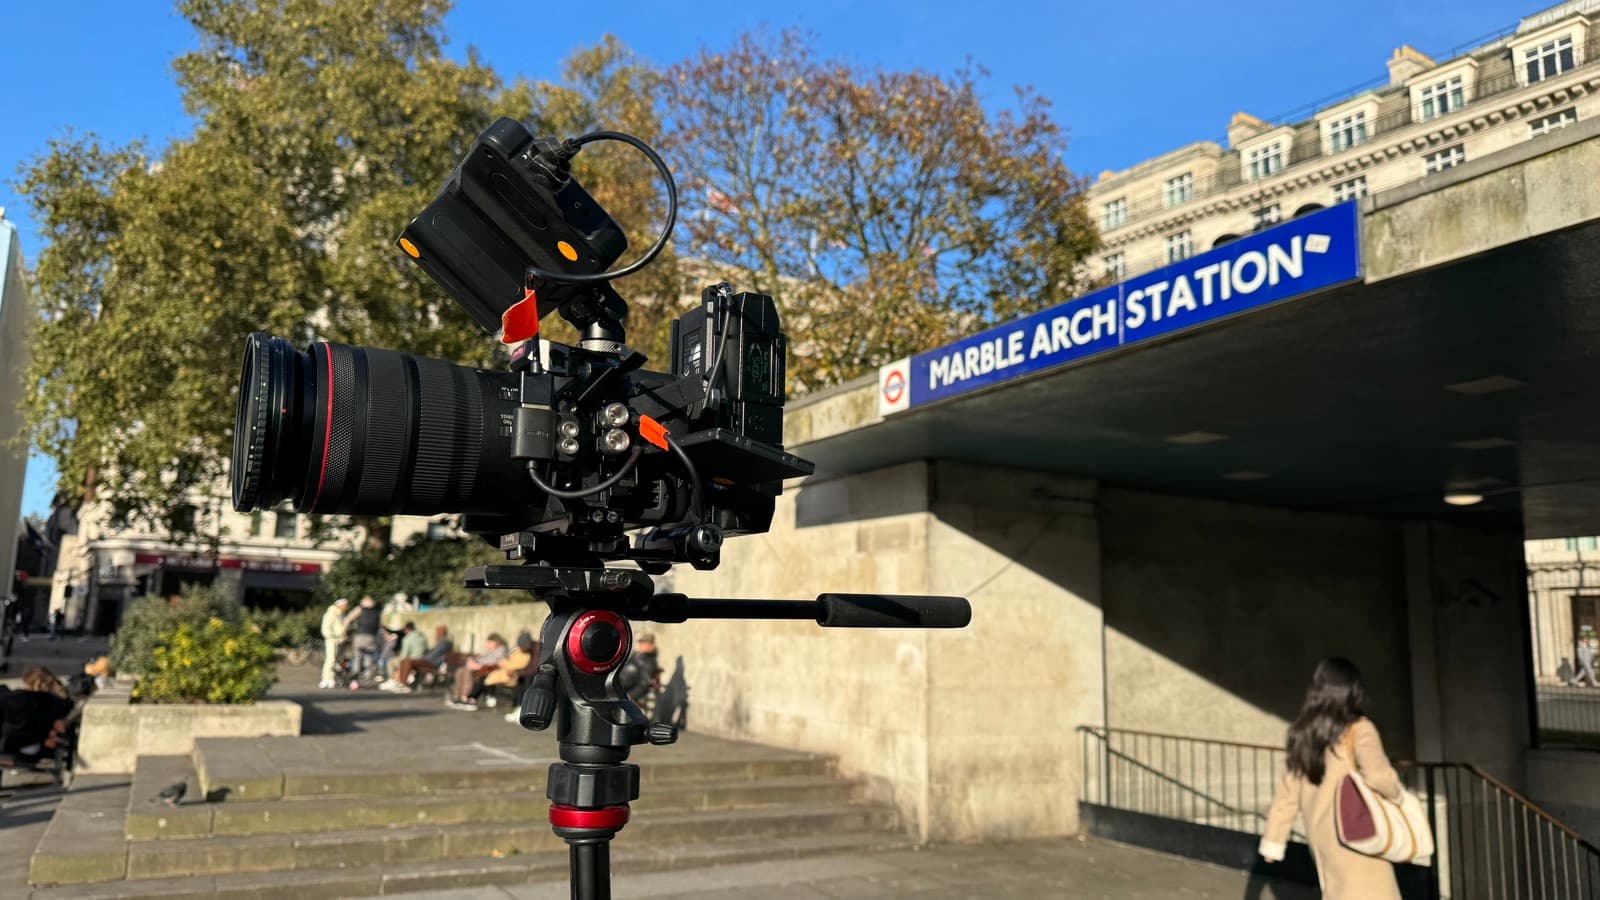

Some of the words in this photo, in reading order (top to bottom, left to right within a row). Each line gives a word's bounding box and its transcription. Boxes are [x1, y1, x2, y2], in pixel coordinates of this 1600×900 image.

[929, 331, 1025, 390] MARBLE
[1030, 300, 1117, 360] ARCH
[1125, 235, 1304, 329] STATION
